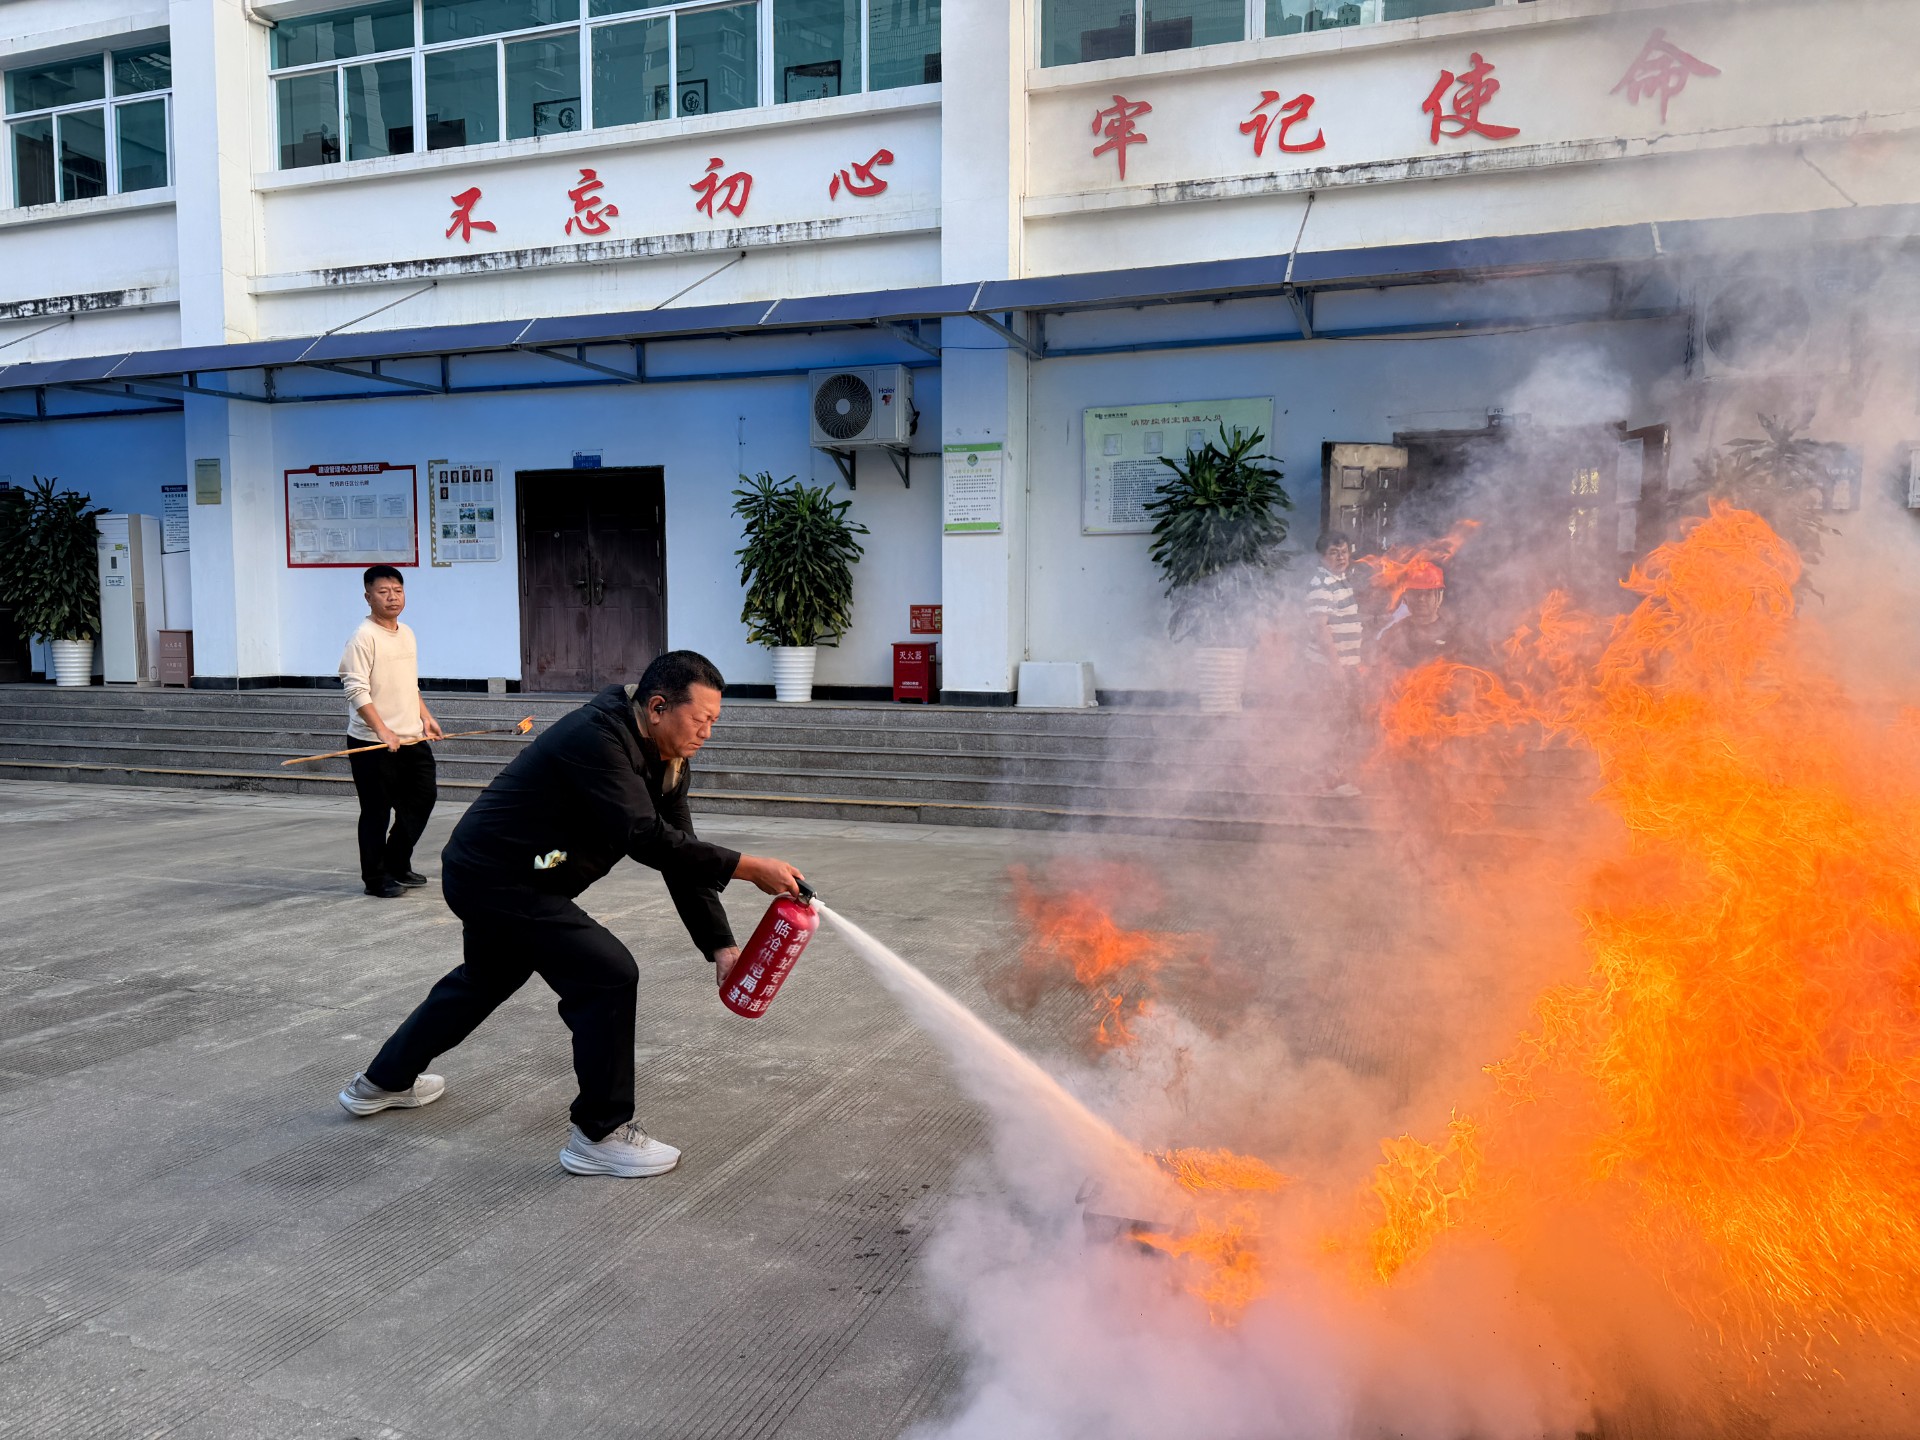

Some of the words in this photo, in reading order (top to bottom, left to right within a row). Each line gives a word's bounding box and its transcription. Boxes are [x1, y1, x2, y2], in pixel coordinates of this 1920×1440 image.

[1090, 27, 1722, 180] 牢记使命
[445, 148, 894, 243] 不忘初心
[899, 650, 922, 660] 灭火器
[740, 919, 793, 993] 临沧供电局
[759, 929, 809, 997] 充电站专用
